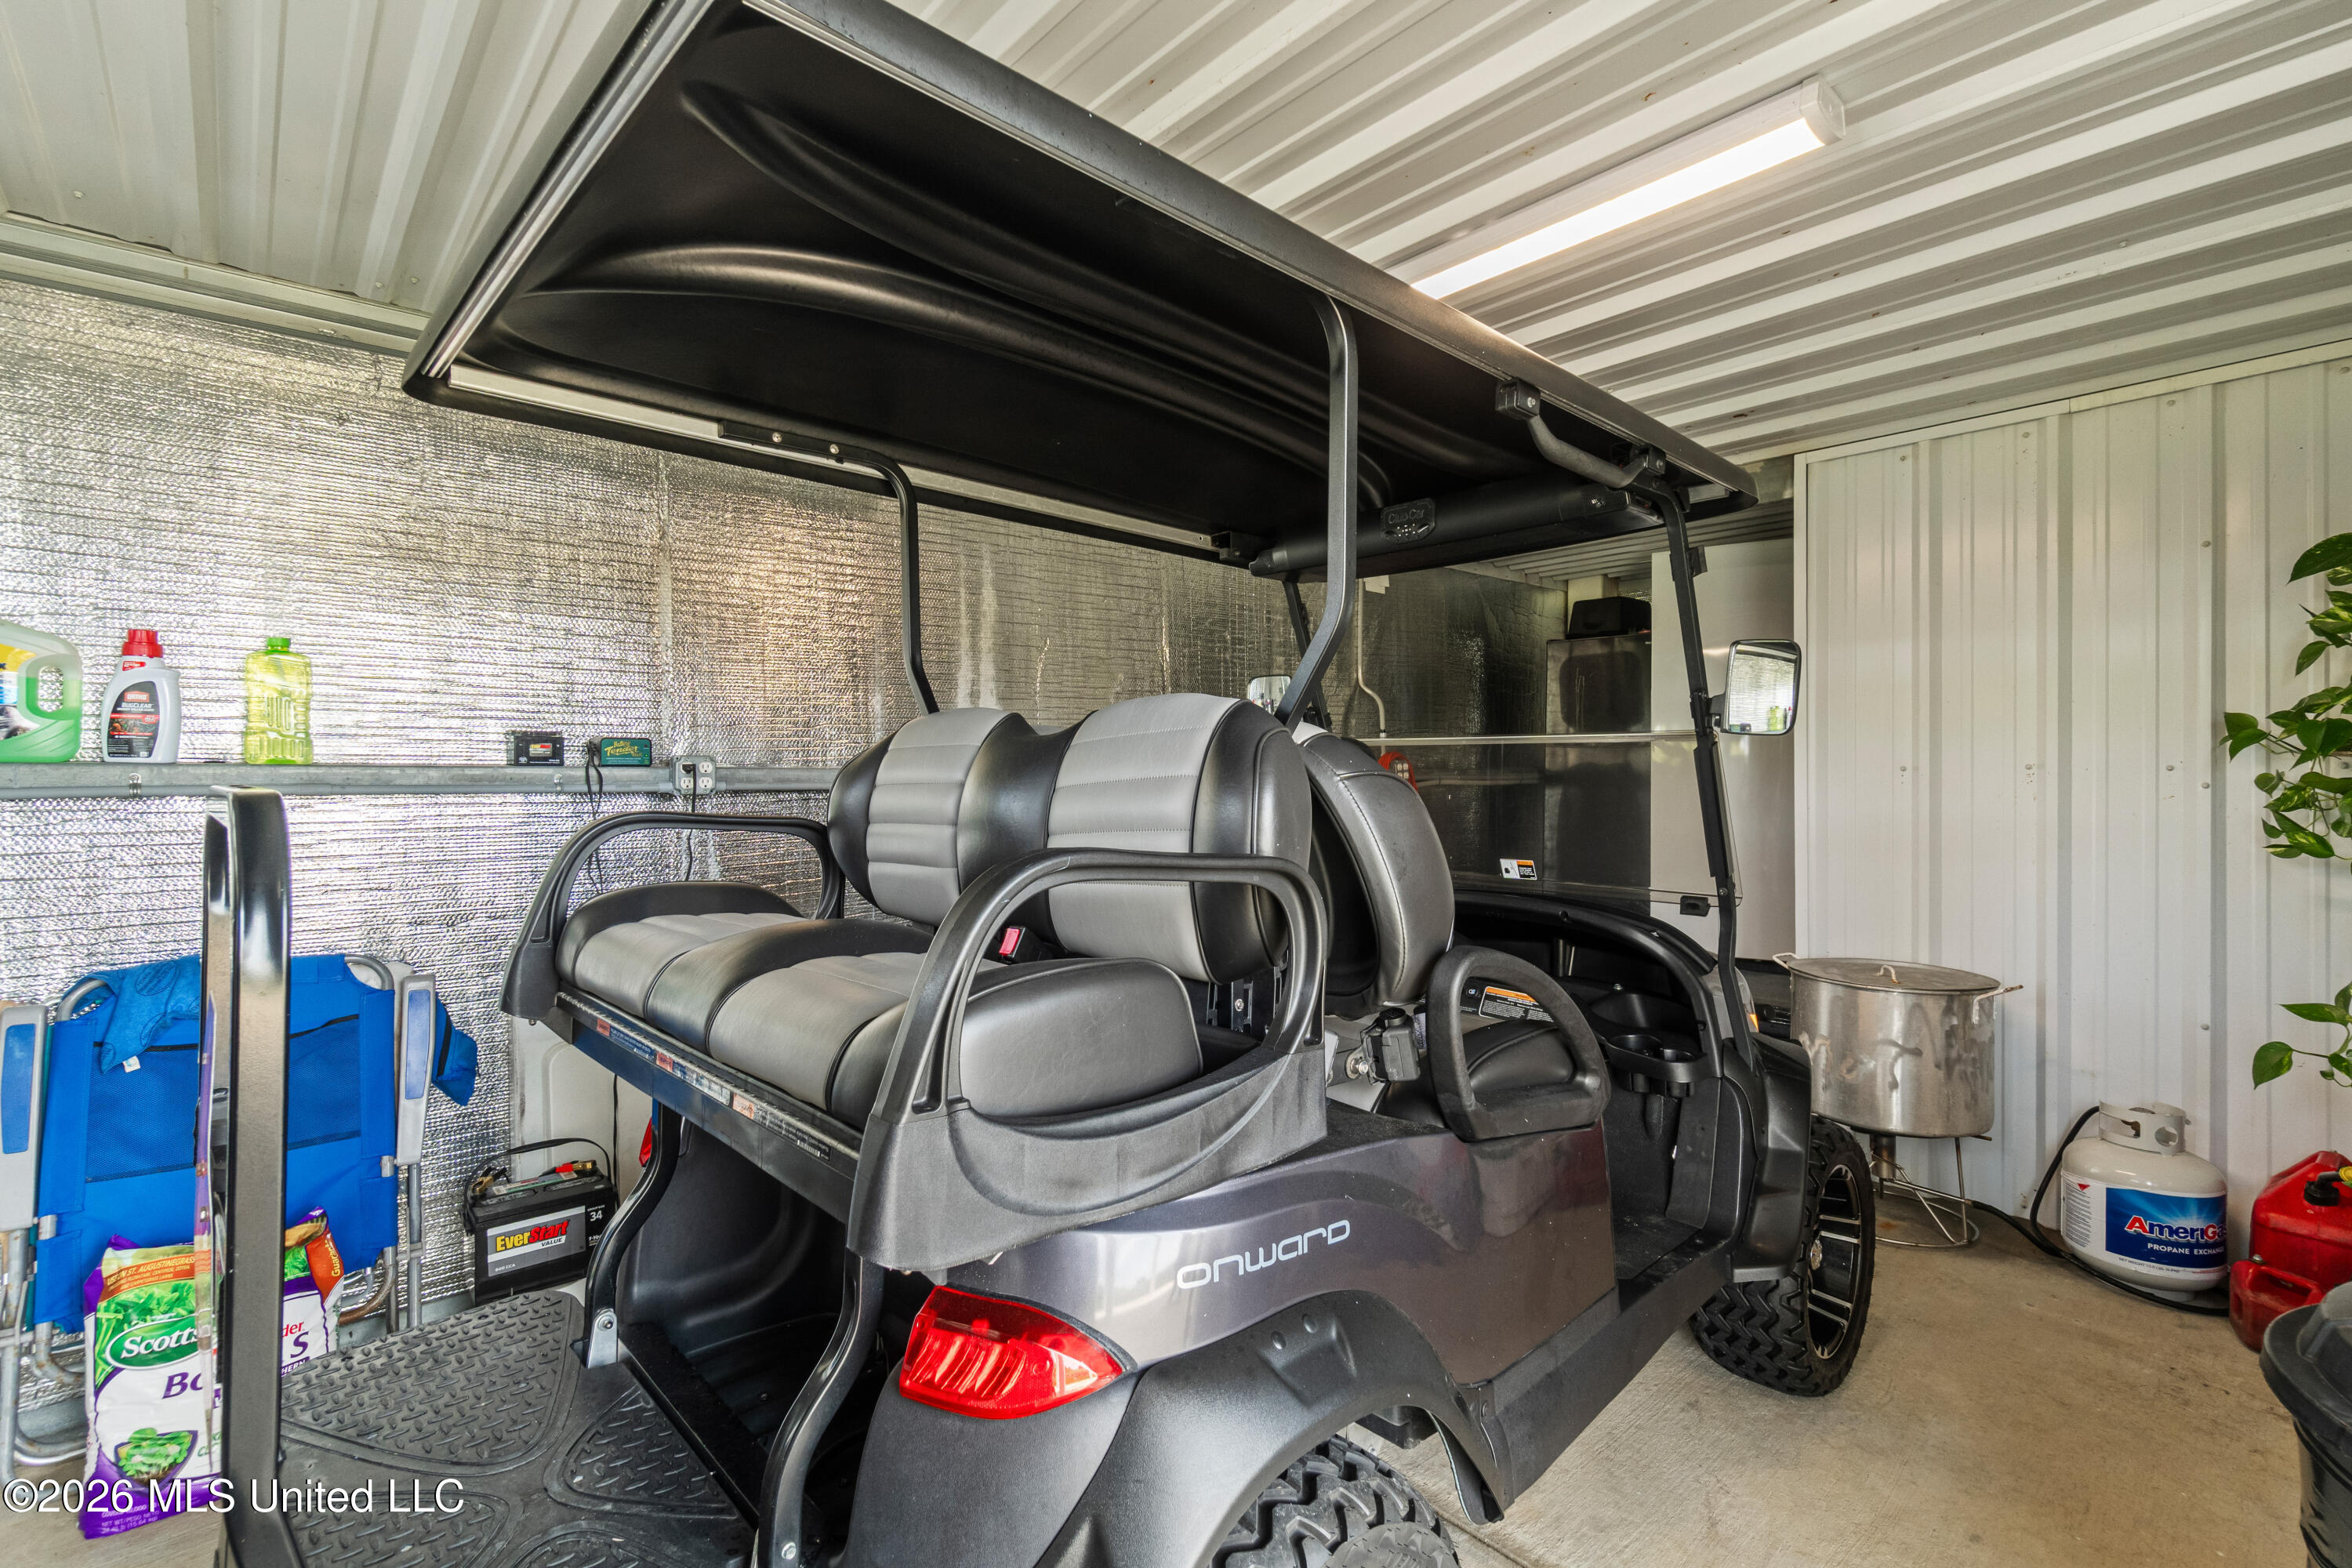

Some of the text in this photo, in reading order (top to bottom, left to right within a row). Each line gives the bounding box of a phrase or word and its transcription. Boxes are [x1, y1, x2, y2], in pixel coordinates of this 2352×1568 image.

[604, 746, 638, 757] Tender
[590, 1210, 603, 1221] 34
[2125, 1215, 2226, 1243] AmeriGa
[495, 1220, 568, 1252] EverStart
[541, 1237, 563, 1247] VALUE
[2147, 1243, 2190, 1254] PROPANE
[1177, 1220, 1350, 1289] onward
[126, 1267, 136, 1277] ST.
[282, 1359, 306, 1375] HERN
